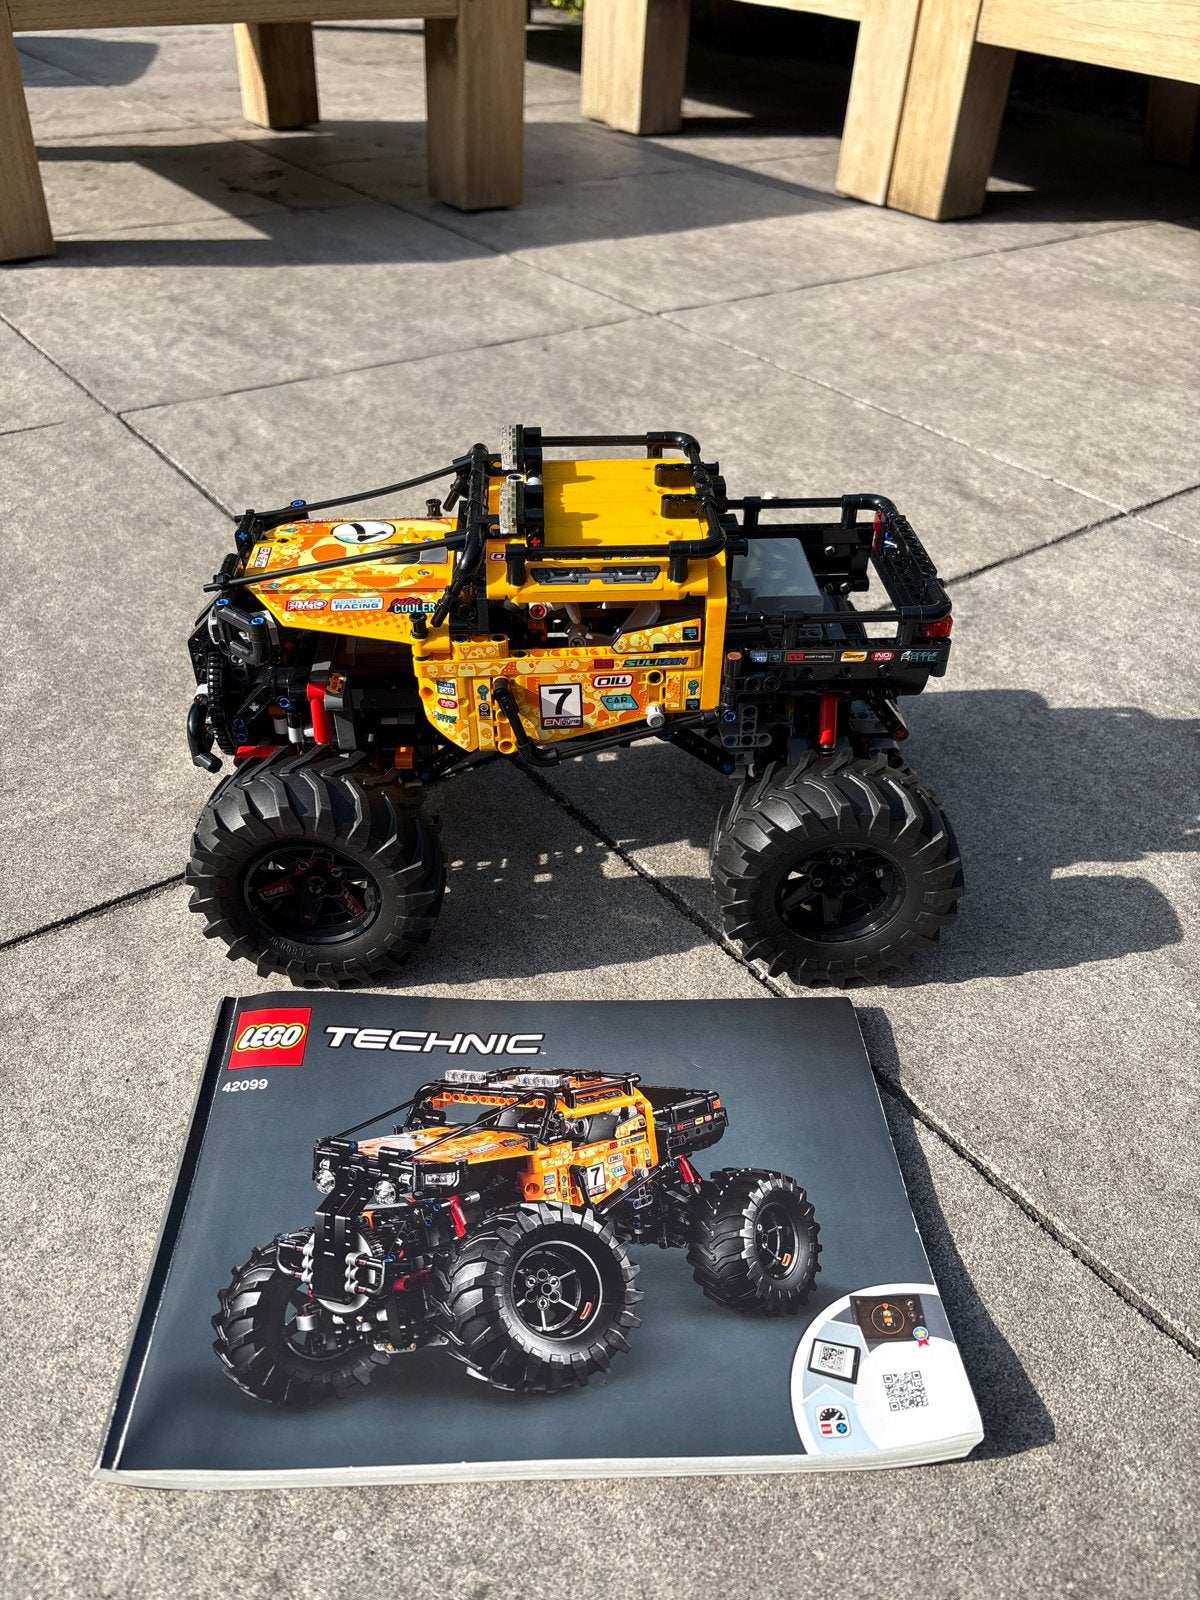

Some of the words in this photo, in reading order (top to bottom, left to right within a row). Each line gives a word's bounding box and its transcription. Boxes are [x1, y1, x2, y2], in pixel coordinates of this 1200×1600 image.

[597, 676, 627, 686] OIL
[549, 688, 573, 715] 7
[238, 1023, 304, 1049] LEGO
[325, 1026, 544, 1054] TECHNIC
[222, 1079, 268, 1093] 42099
[591, 1167, 600, 1186] 7
